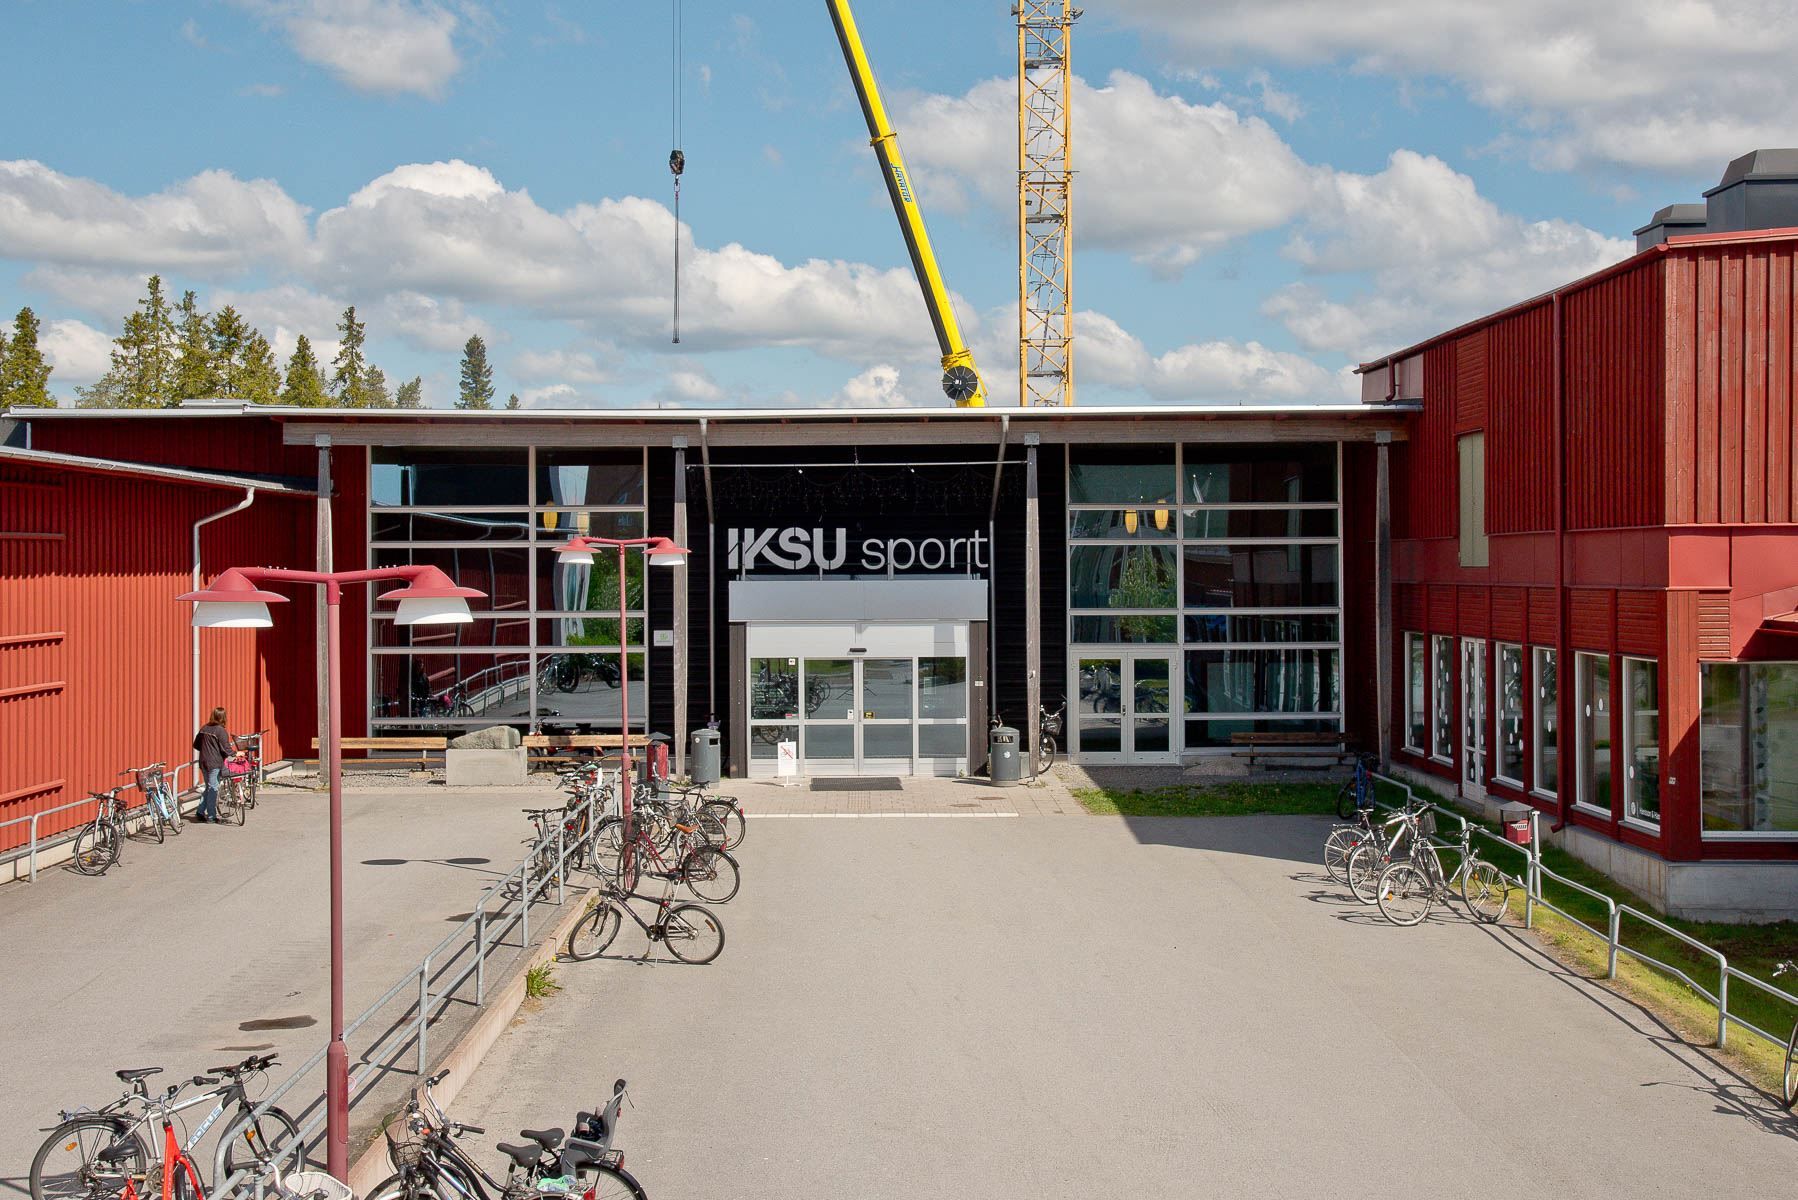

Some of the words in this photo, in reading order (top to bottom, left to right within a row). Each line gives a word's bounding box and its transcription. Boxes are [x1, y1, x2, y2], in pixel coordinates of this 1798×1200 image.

[728, 527, 846, 570] IKSU
[861, 529, 989, 570] sport
[190, 1107, 221, 1145] FOCUS
